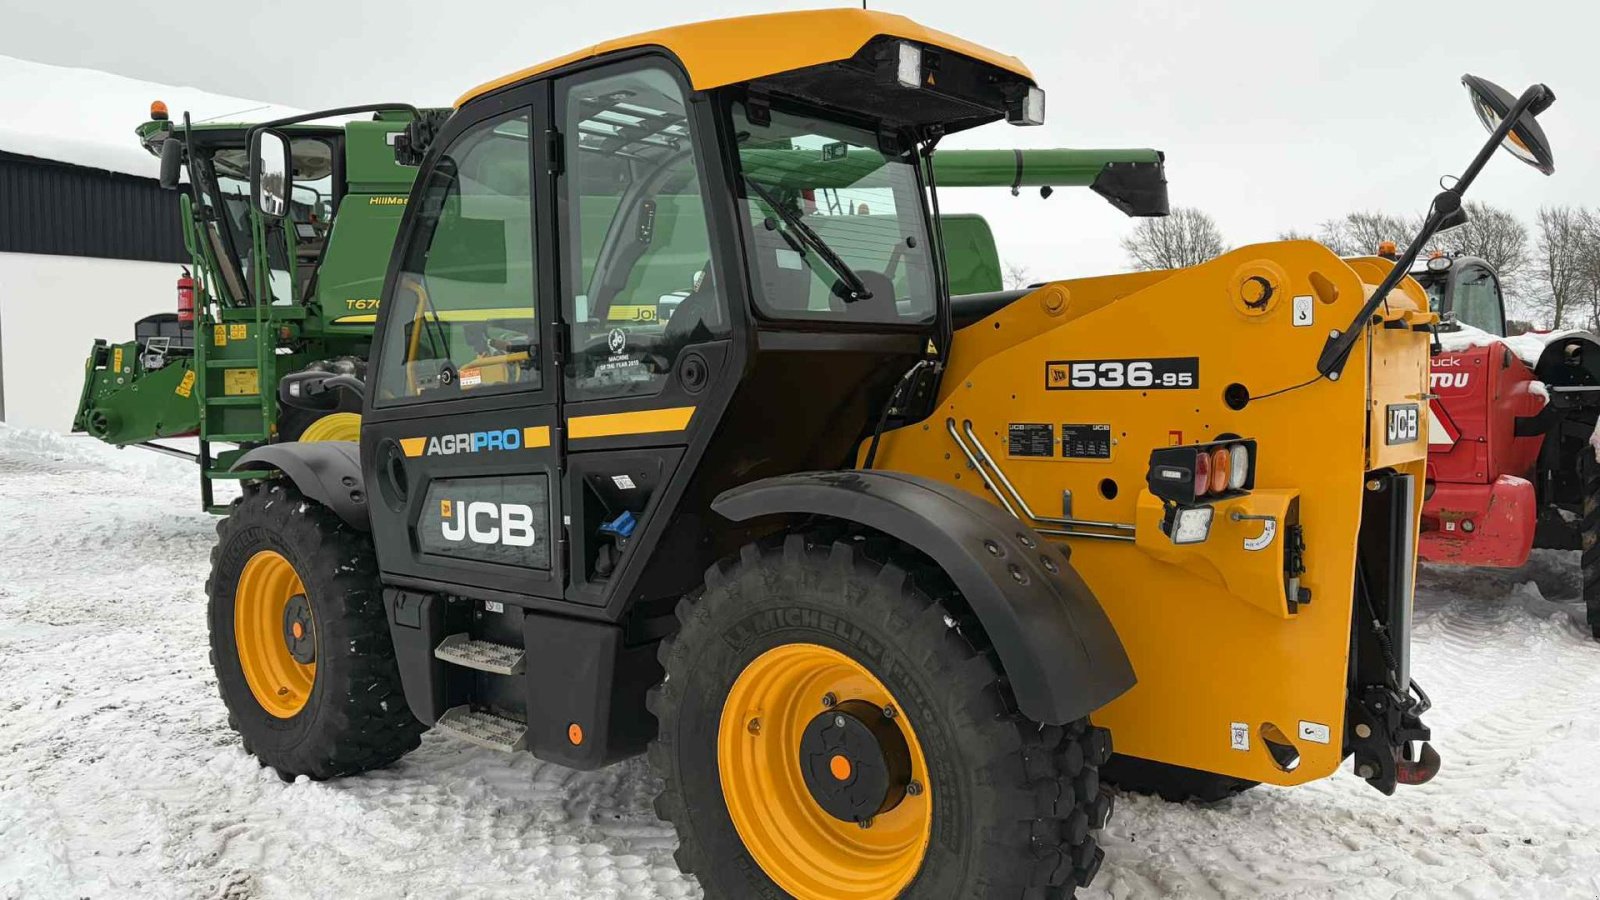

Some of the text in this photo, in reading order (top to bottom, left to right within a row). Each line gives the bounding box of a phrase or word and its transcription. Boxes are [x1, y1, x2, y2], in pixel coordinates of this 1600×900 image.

[1389, 409, 1417, 441] JCB
[441, 500, 535, 547] JCB
[752, 607, 883, 657] MICHELIN
